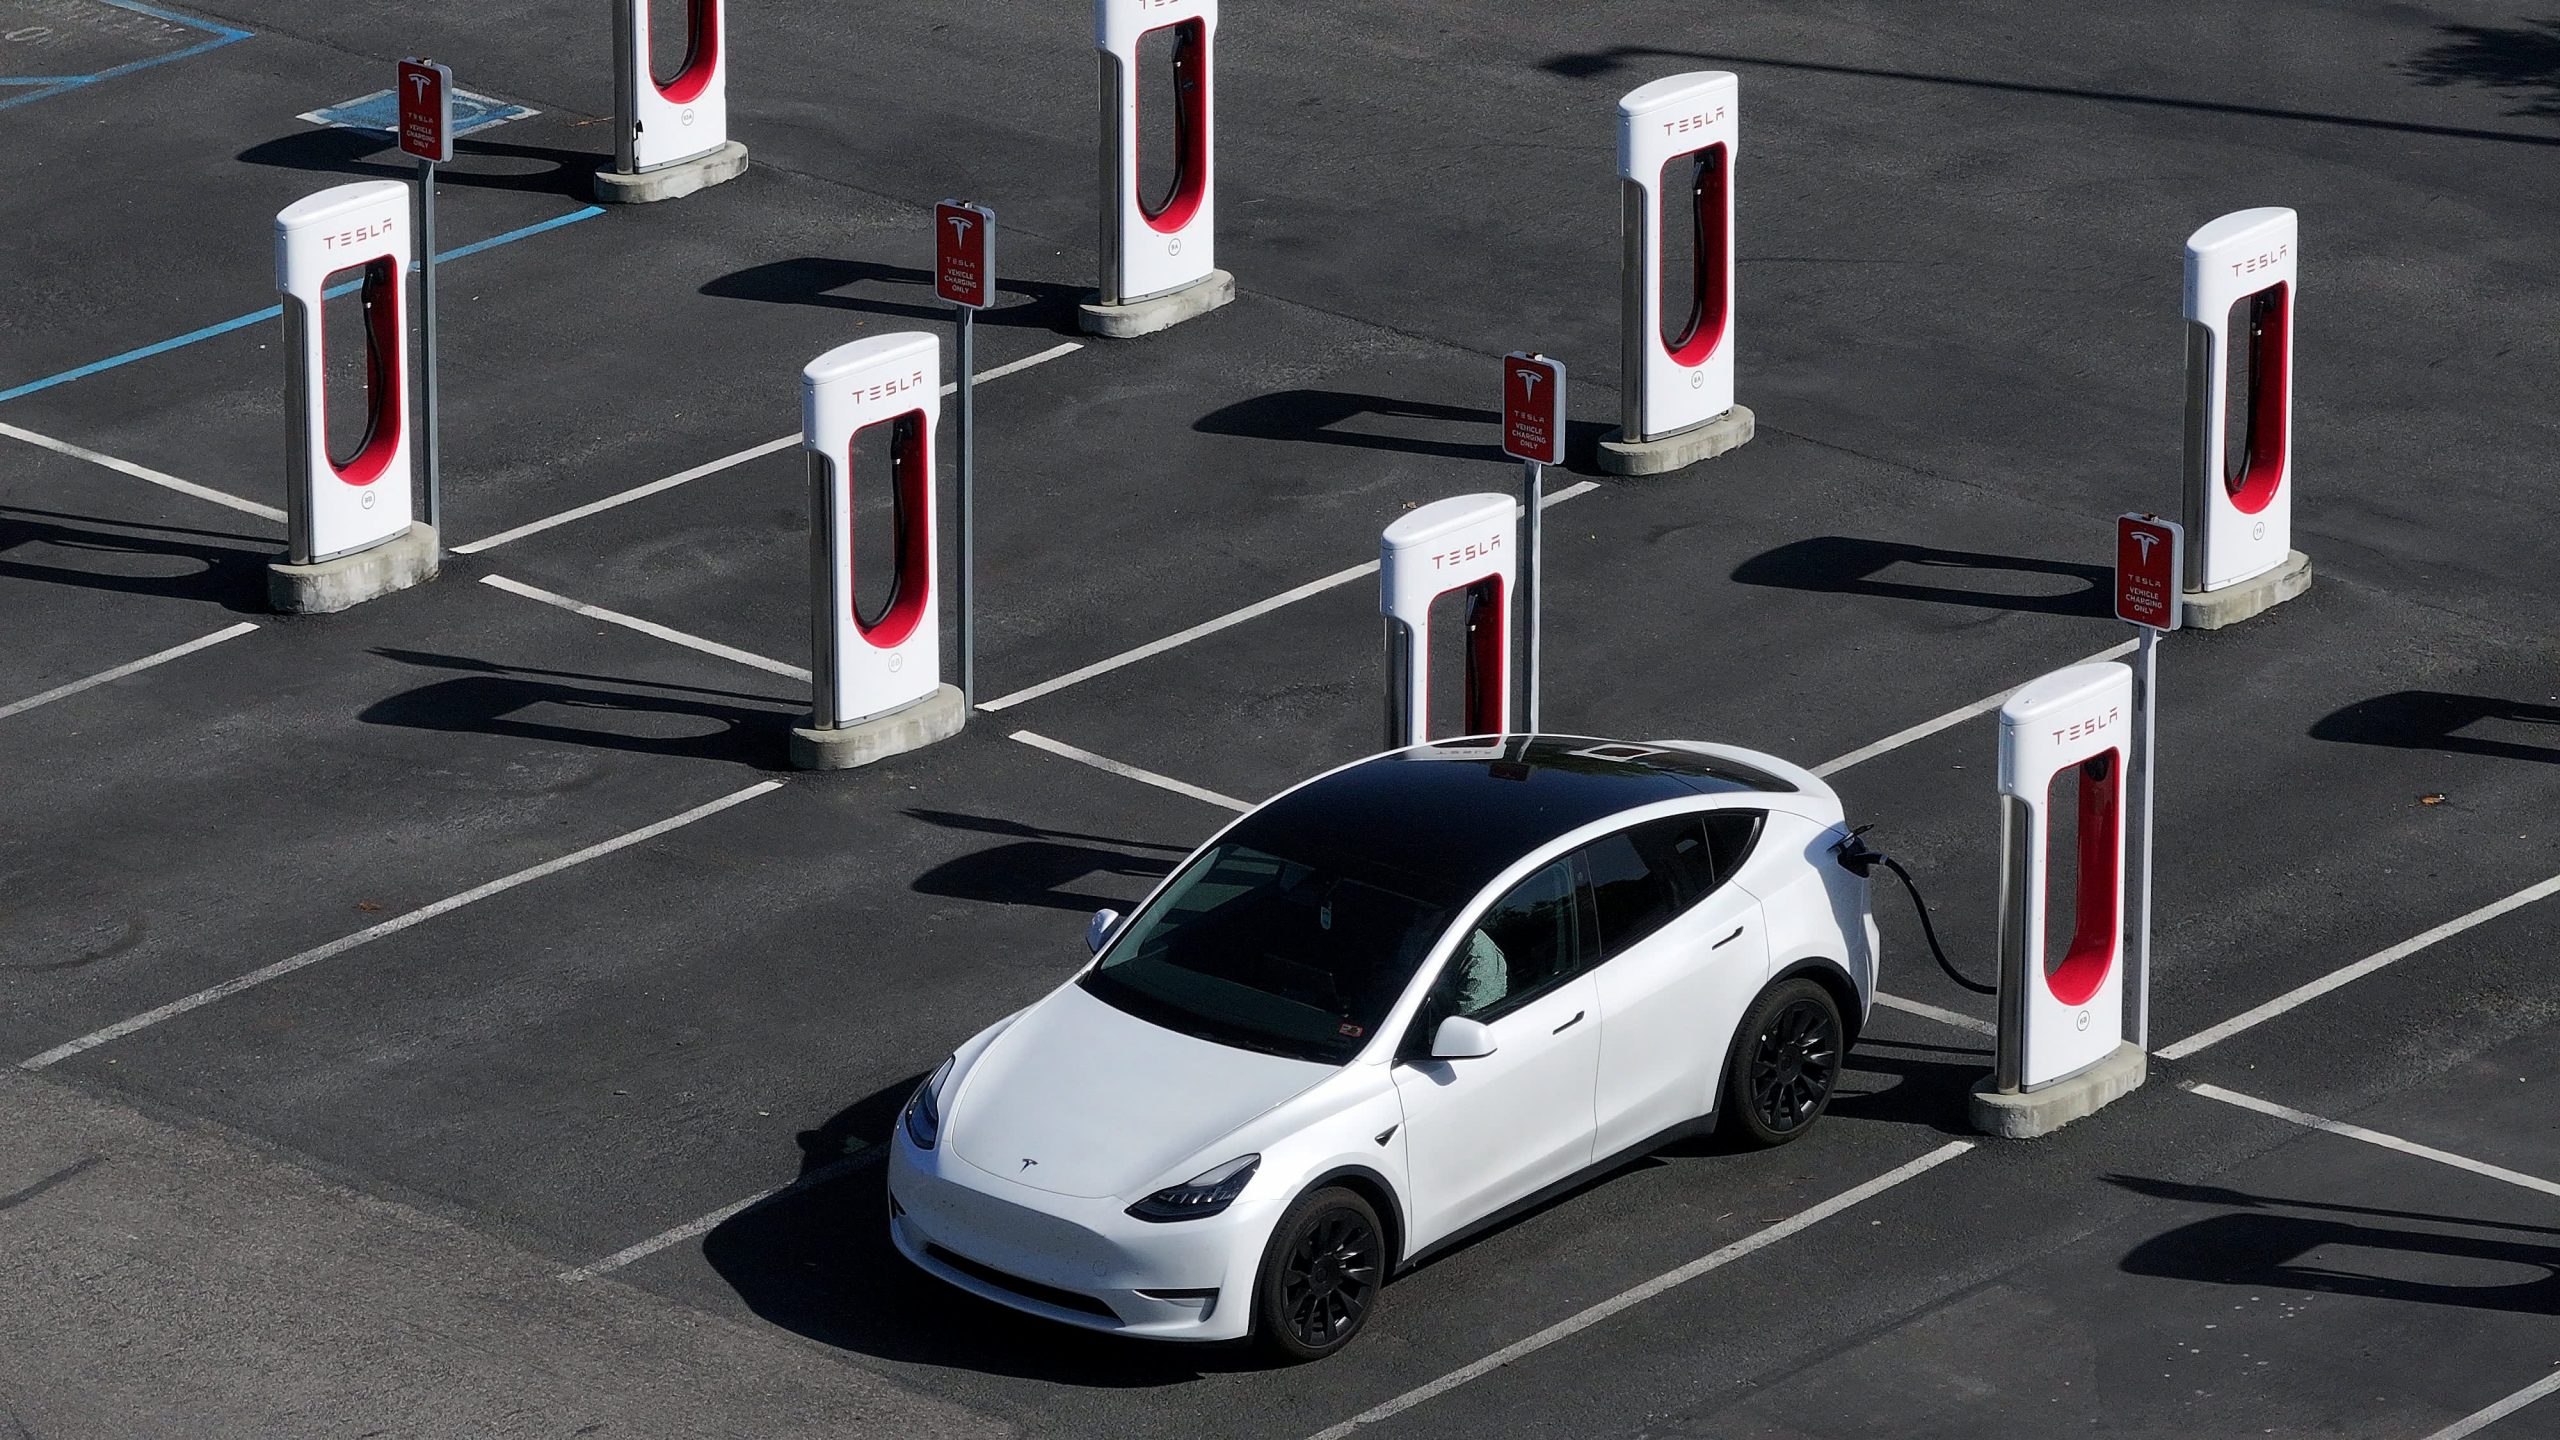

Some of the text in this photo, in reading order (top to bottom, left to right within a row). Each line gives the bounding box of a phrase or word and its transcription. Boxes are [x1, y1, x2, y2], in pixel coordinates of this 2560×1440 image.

[408, 112, 434, 124] TESLA
[1663, 106, 1725, 137] TESLA
[409, 123, 433, 135] VEHICLE
[406, 130, 436, 143] CHARGING
[412, 139, 429, 150] ONLY
[322, 217, 393, 250] TESLA
[945, 256, 976, 268] TESLA
[2232, 244, 2287, 277] TESLA
[947, 268, 975, 280] VEHICLE
[944, 274, 977, 289] CHARGING
[952, 284, 970, 295] ONLY
[852, 371, 922, 404] TESLA
[1513, 410, 1545, 424] TESLA
[1515, 422, 1543, 435] VEHICLE
[1511, 429, 1547, 445] CHARGING
[1520, 439, 1538, 451] ONLY
[1432, 534, 1501, 569] TESLA
[2128, 573, 2162, 588] TESLA
[2129, 587, 2160, 600] VEHICLE
[2125, 594, 2163, 610] CHARGING
[2134, 604, 2154, 616] ONLY
[2052, 706, 2119, 745] TESLA
